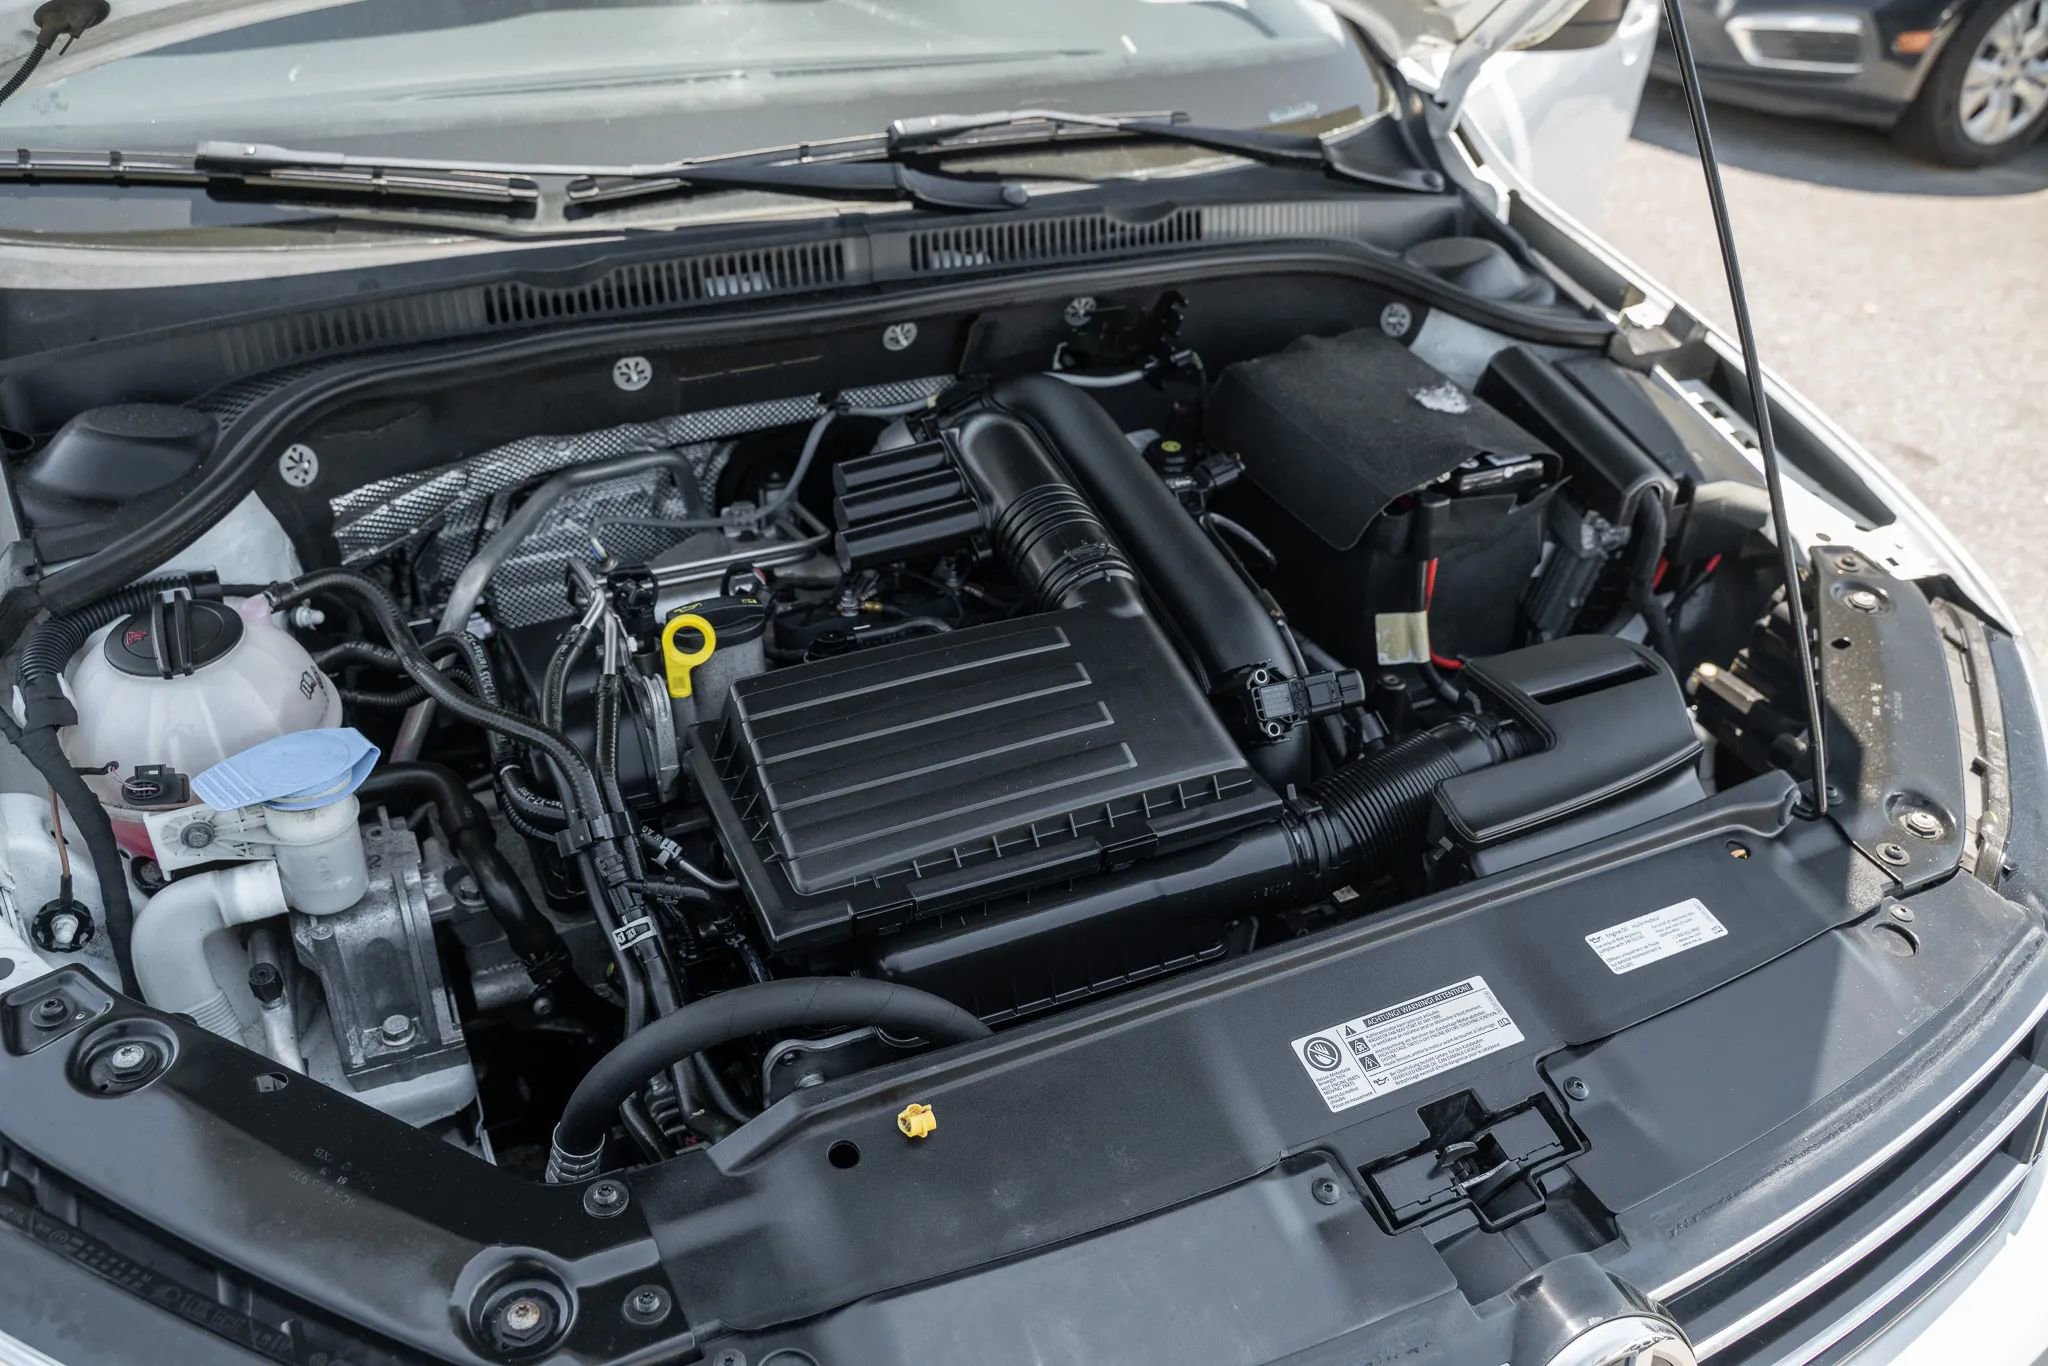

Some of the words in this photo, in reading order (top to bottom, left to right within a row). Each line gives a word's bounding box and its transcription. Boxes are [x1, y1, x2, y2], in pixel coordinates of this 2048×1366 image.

[1366, 1009, 1402, 1026] ACHTUNG!
[1400, 997, 1435, 1014] WARNING!
[1433, 984, 1471, 1002] ATTENTION!
[1430, 1031, 1445, 1039] ENGINE
[1459, 1018, 1480, 1028] TOUCHING
[1479, 1012, 1497, 1021] IGNITION
[1368, 1034, 1388, 1043] RADIATOR
[1415, 1064, 1431, 1072] ENGINE
[1447, 1051, 1465, 1060] DAMAGE
[1324, 1086, 1343, 1096] MOVING
[1342, 1081, 1355, 1089] PARTS
[1331, 1079, 1347, 1088] ENGINE
[1347, 1074, 1360, 1082] PARTS
